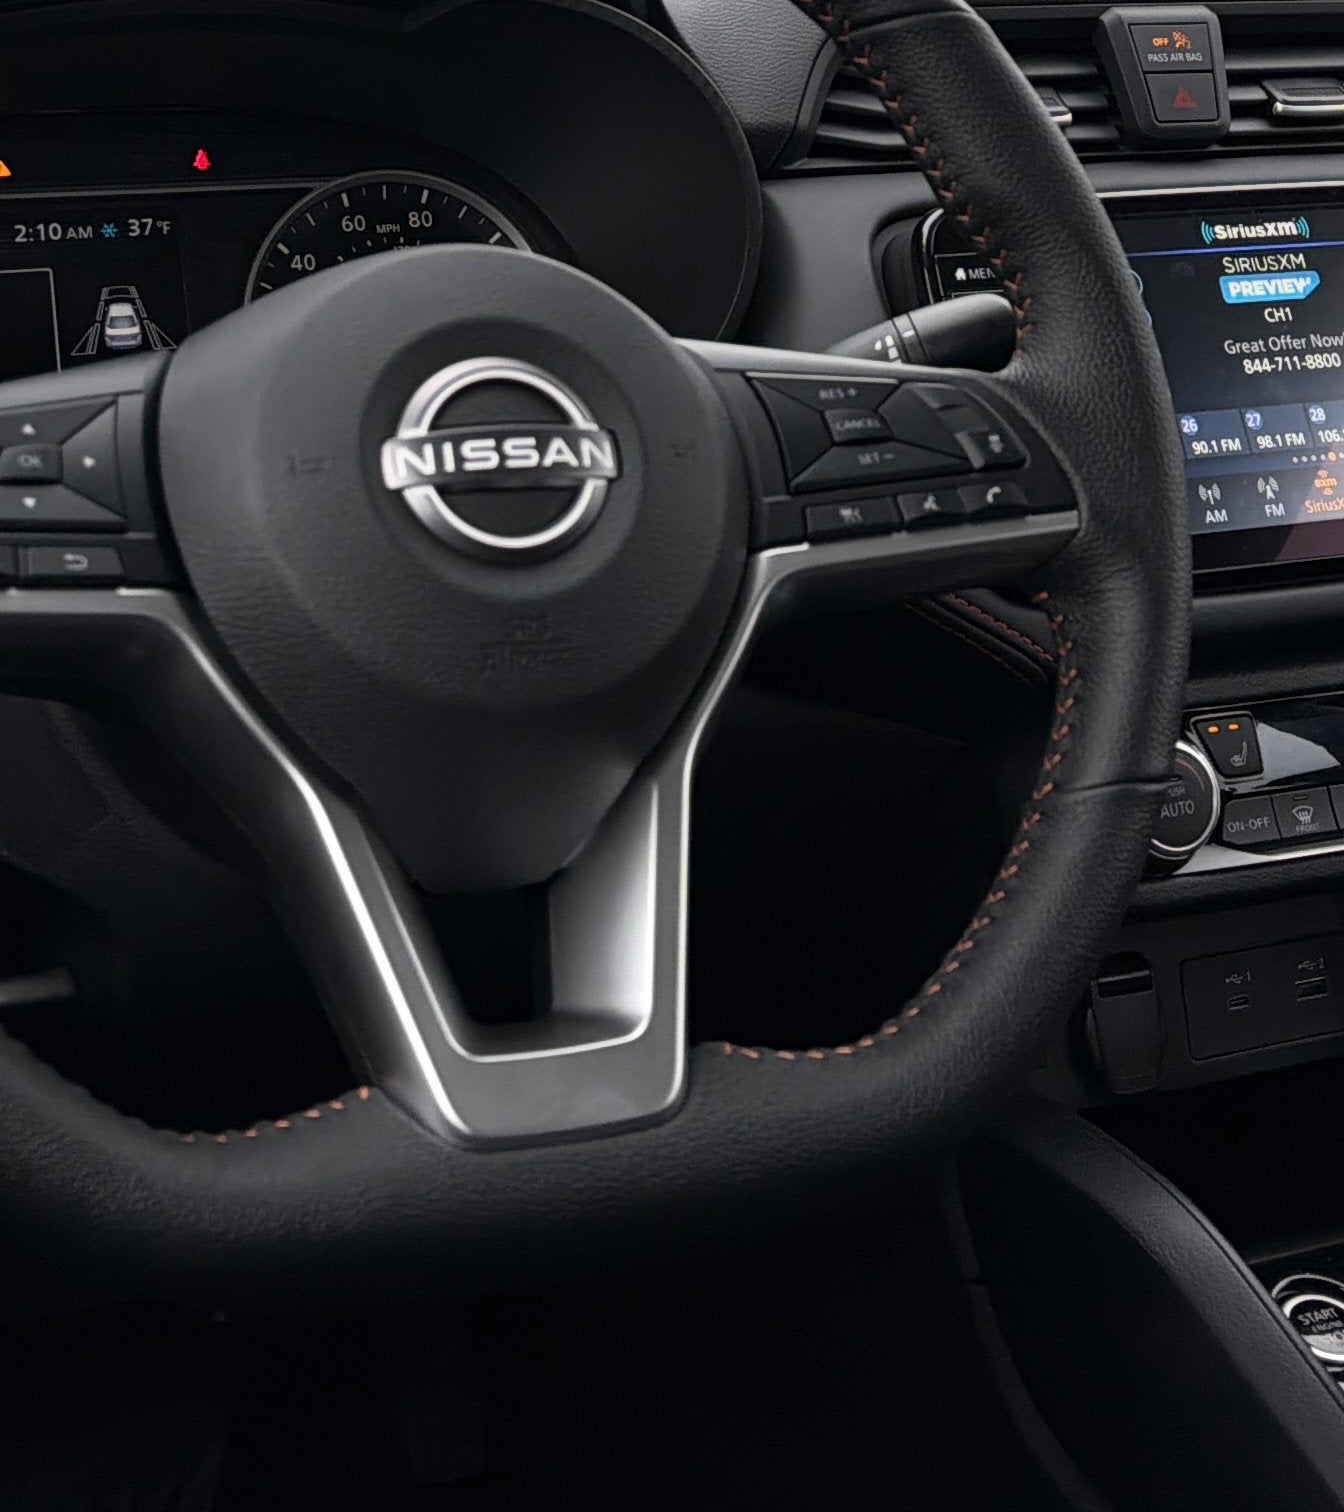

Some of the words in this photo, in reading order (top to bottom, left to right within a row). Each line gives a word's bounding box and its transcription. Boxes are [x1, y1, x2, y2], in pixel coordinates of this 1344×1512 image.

[1152, 38, 1169, 46] OFF
[1147, 53, 1168, 62] PASS
[1170, 53, 1184, 61] AIR
[1186, 53, 1202, 61] BAG
[341, 214, 366, 232] 60
[408, 211, 433, 228] 80
[13, 222, 62, 244] 2:10
[66, 225, 93, 240] AM
[376, 224, 400, 234] MPH
[290, 253, 316, 271] 40
[1222, 253, 1307, 274] SIRIUSXM
[968, 268, 996, 279] MEN
[1228, 276, 1312, 298] PREVIEW
[1264, 307, 1293, 323] CH1
[1224, 339, 1265, 355] Great
[1269, 334, 1307, 351] Offer
[1243, 352, 1341, 375] 844-711-8800
[1245, 412, 1261, 427] 27
[1309, 407, 1326, 422] 28
[835, 418, 880, 431] CANCEL
[1181, 418, 1198, 433] 26
[1192, 439, 1218, 455] 90.1
[1221, 438, 1242, 451] FM
[1256, 434, 1282, 449] 98.1
[1285, 432, 1306, 446] FM
[395, 436, 614, 478] NISSAN
[1205, 508, 1229, 524] AM
[1264, 502, 1286, 517] FM
[1160, 800, 1195, 820] AUTO
[1297, 1308, 1338, 1326] START
